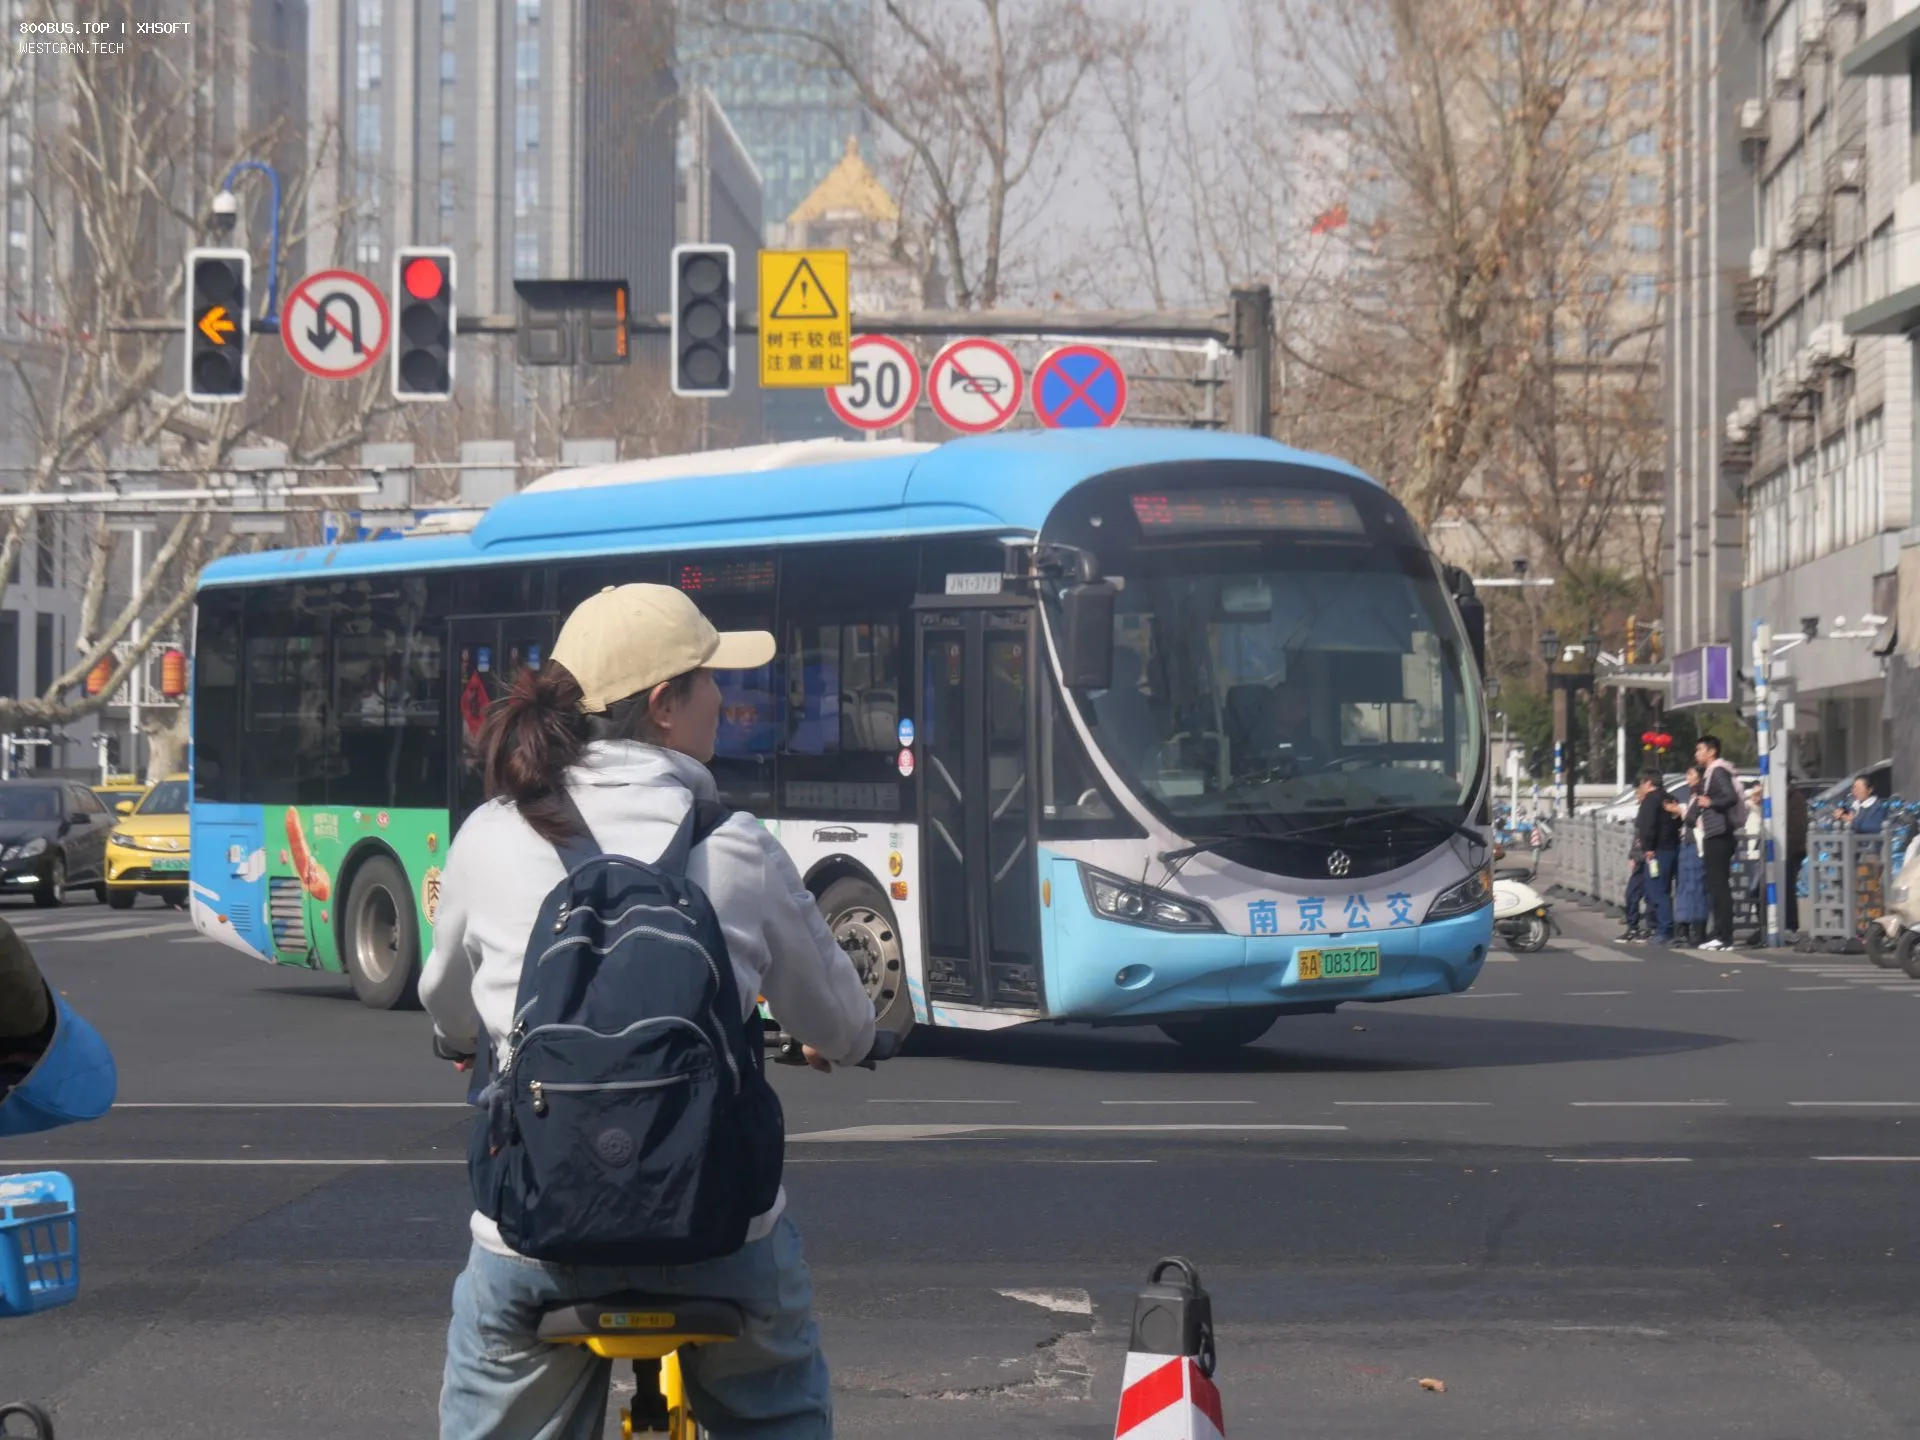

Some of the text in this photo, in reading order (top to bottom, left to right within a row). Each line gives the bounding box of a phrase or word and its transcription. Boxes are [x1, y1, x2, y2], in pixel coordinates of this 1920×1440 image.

[767, 330, 844, 349] 树干较低
[767, 353, 844, 371] 注意避让
[848, 361, 900, 410] 50
[1247, 892, 1415, 935] 南京公交
